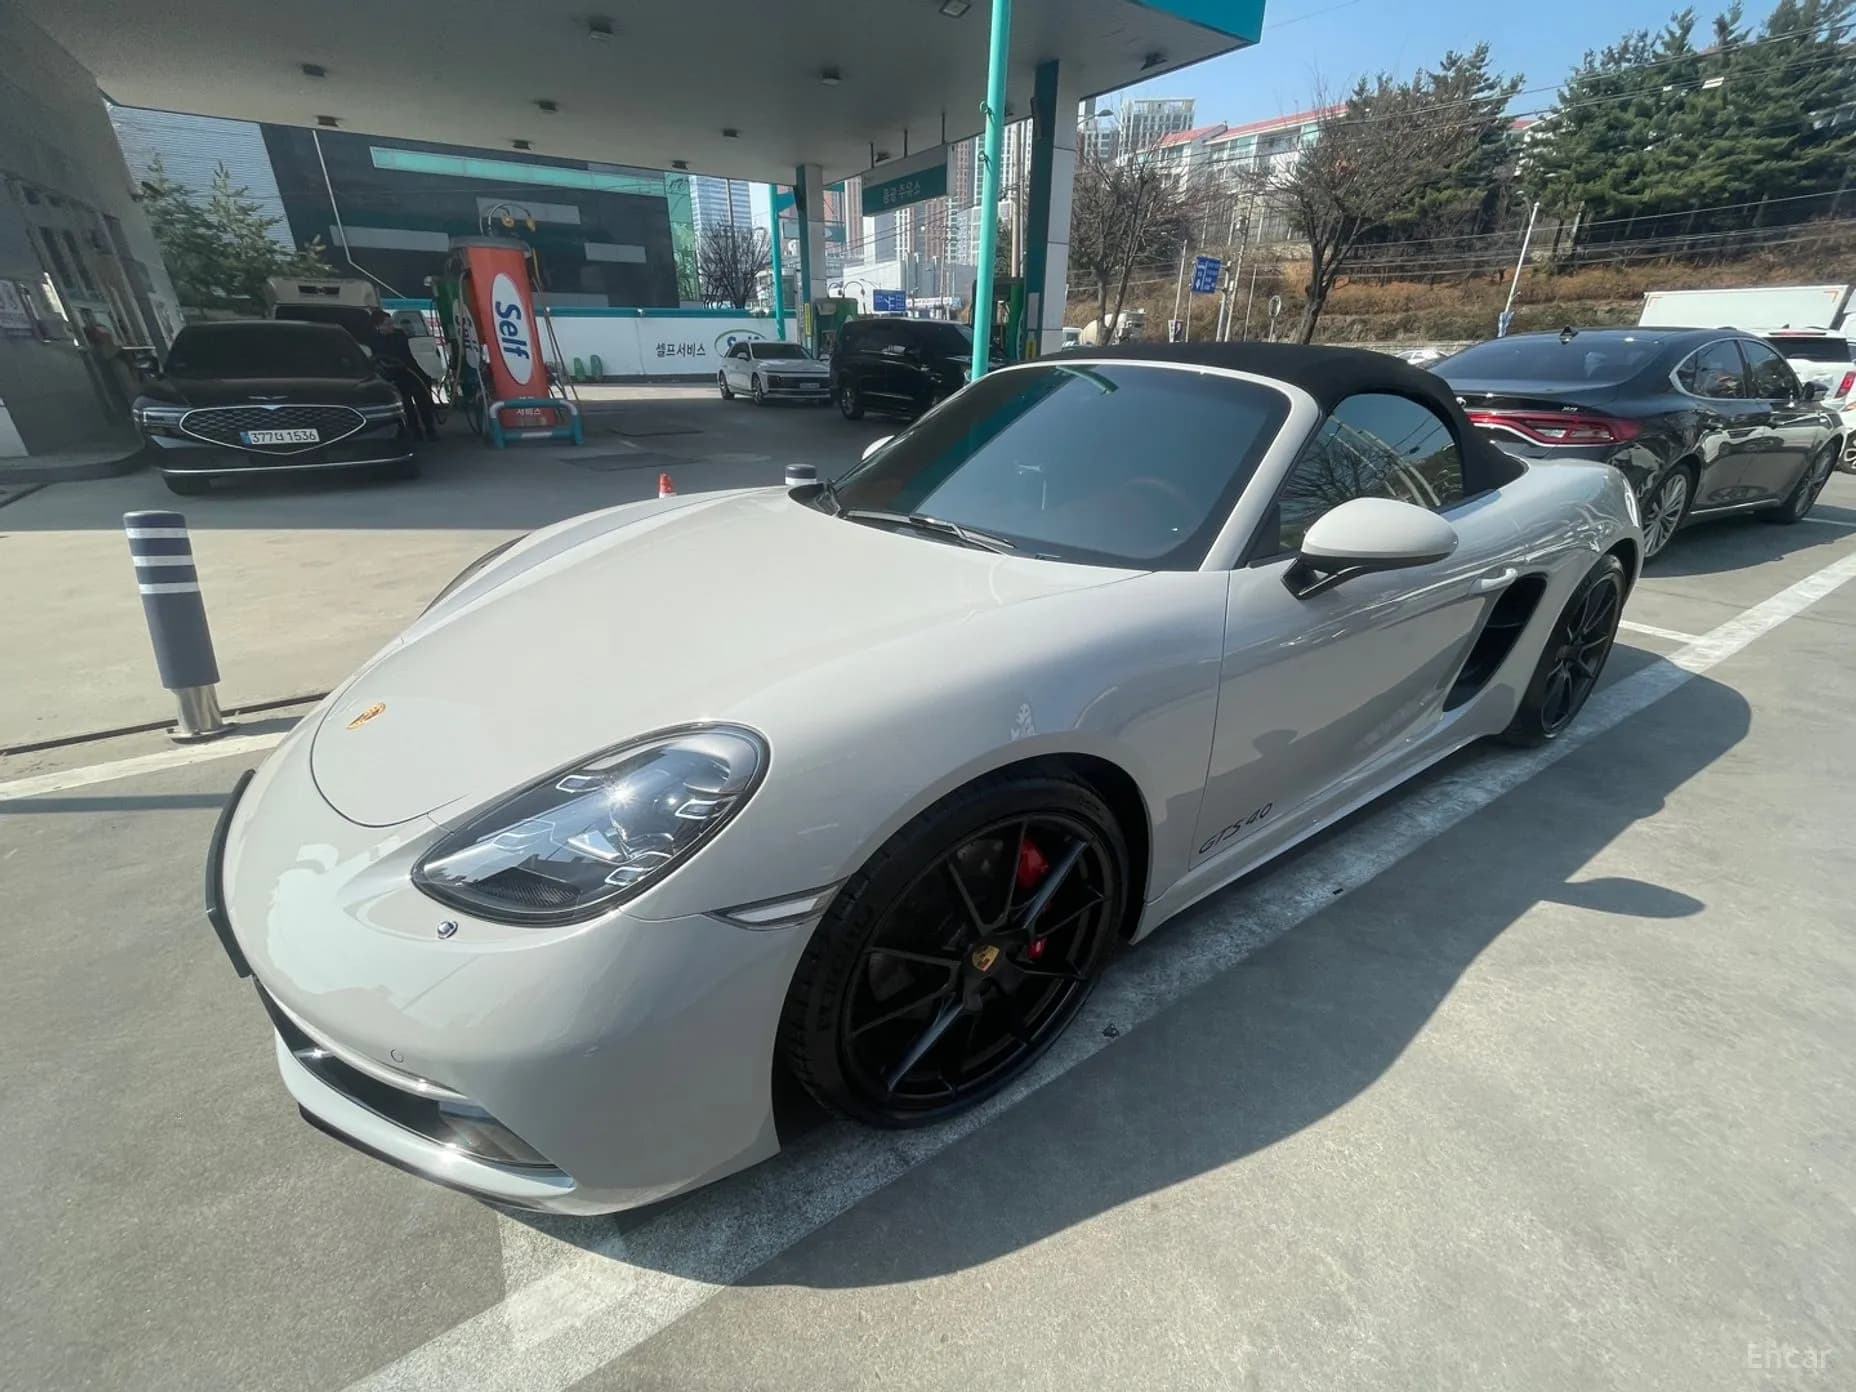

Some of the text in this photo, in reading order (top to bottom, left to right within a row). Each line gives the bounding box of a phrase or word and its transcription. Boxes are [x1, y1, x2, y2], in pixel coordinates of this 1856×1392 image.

[495, 300, 531, 360] Self
[655, 341, 706, 358] 셀프서비스
[287, 430, 317, 441] 1536
[1199, 817, 1246, 854] GTS
